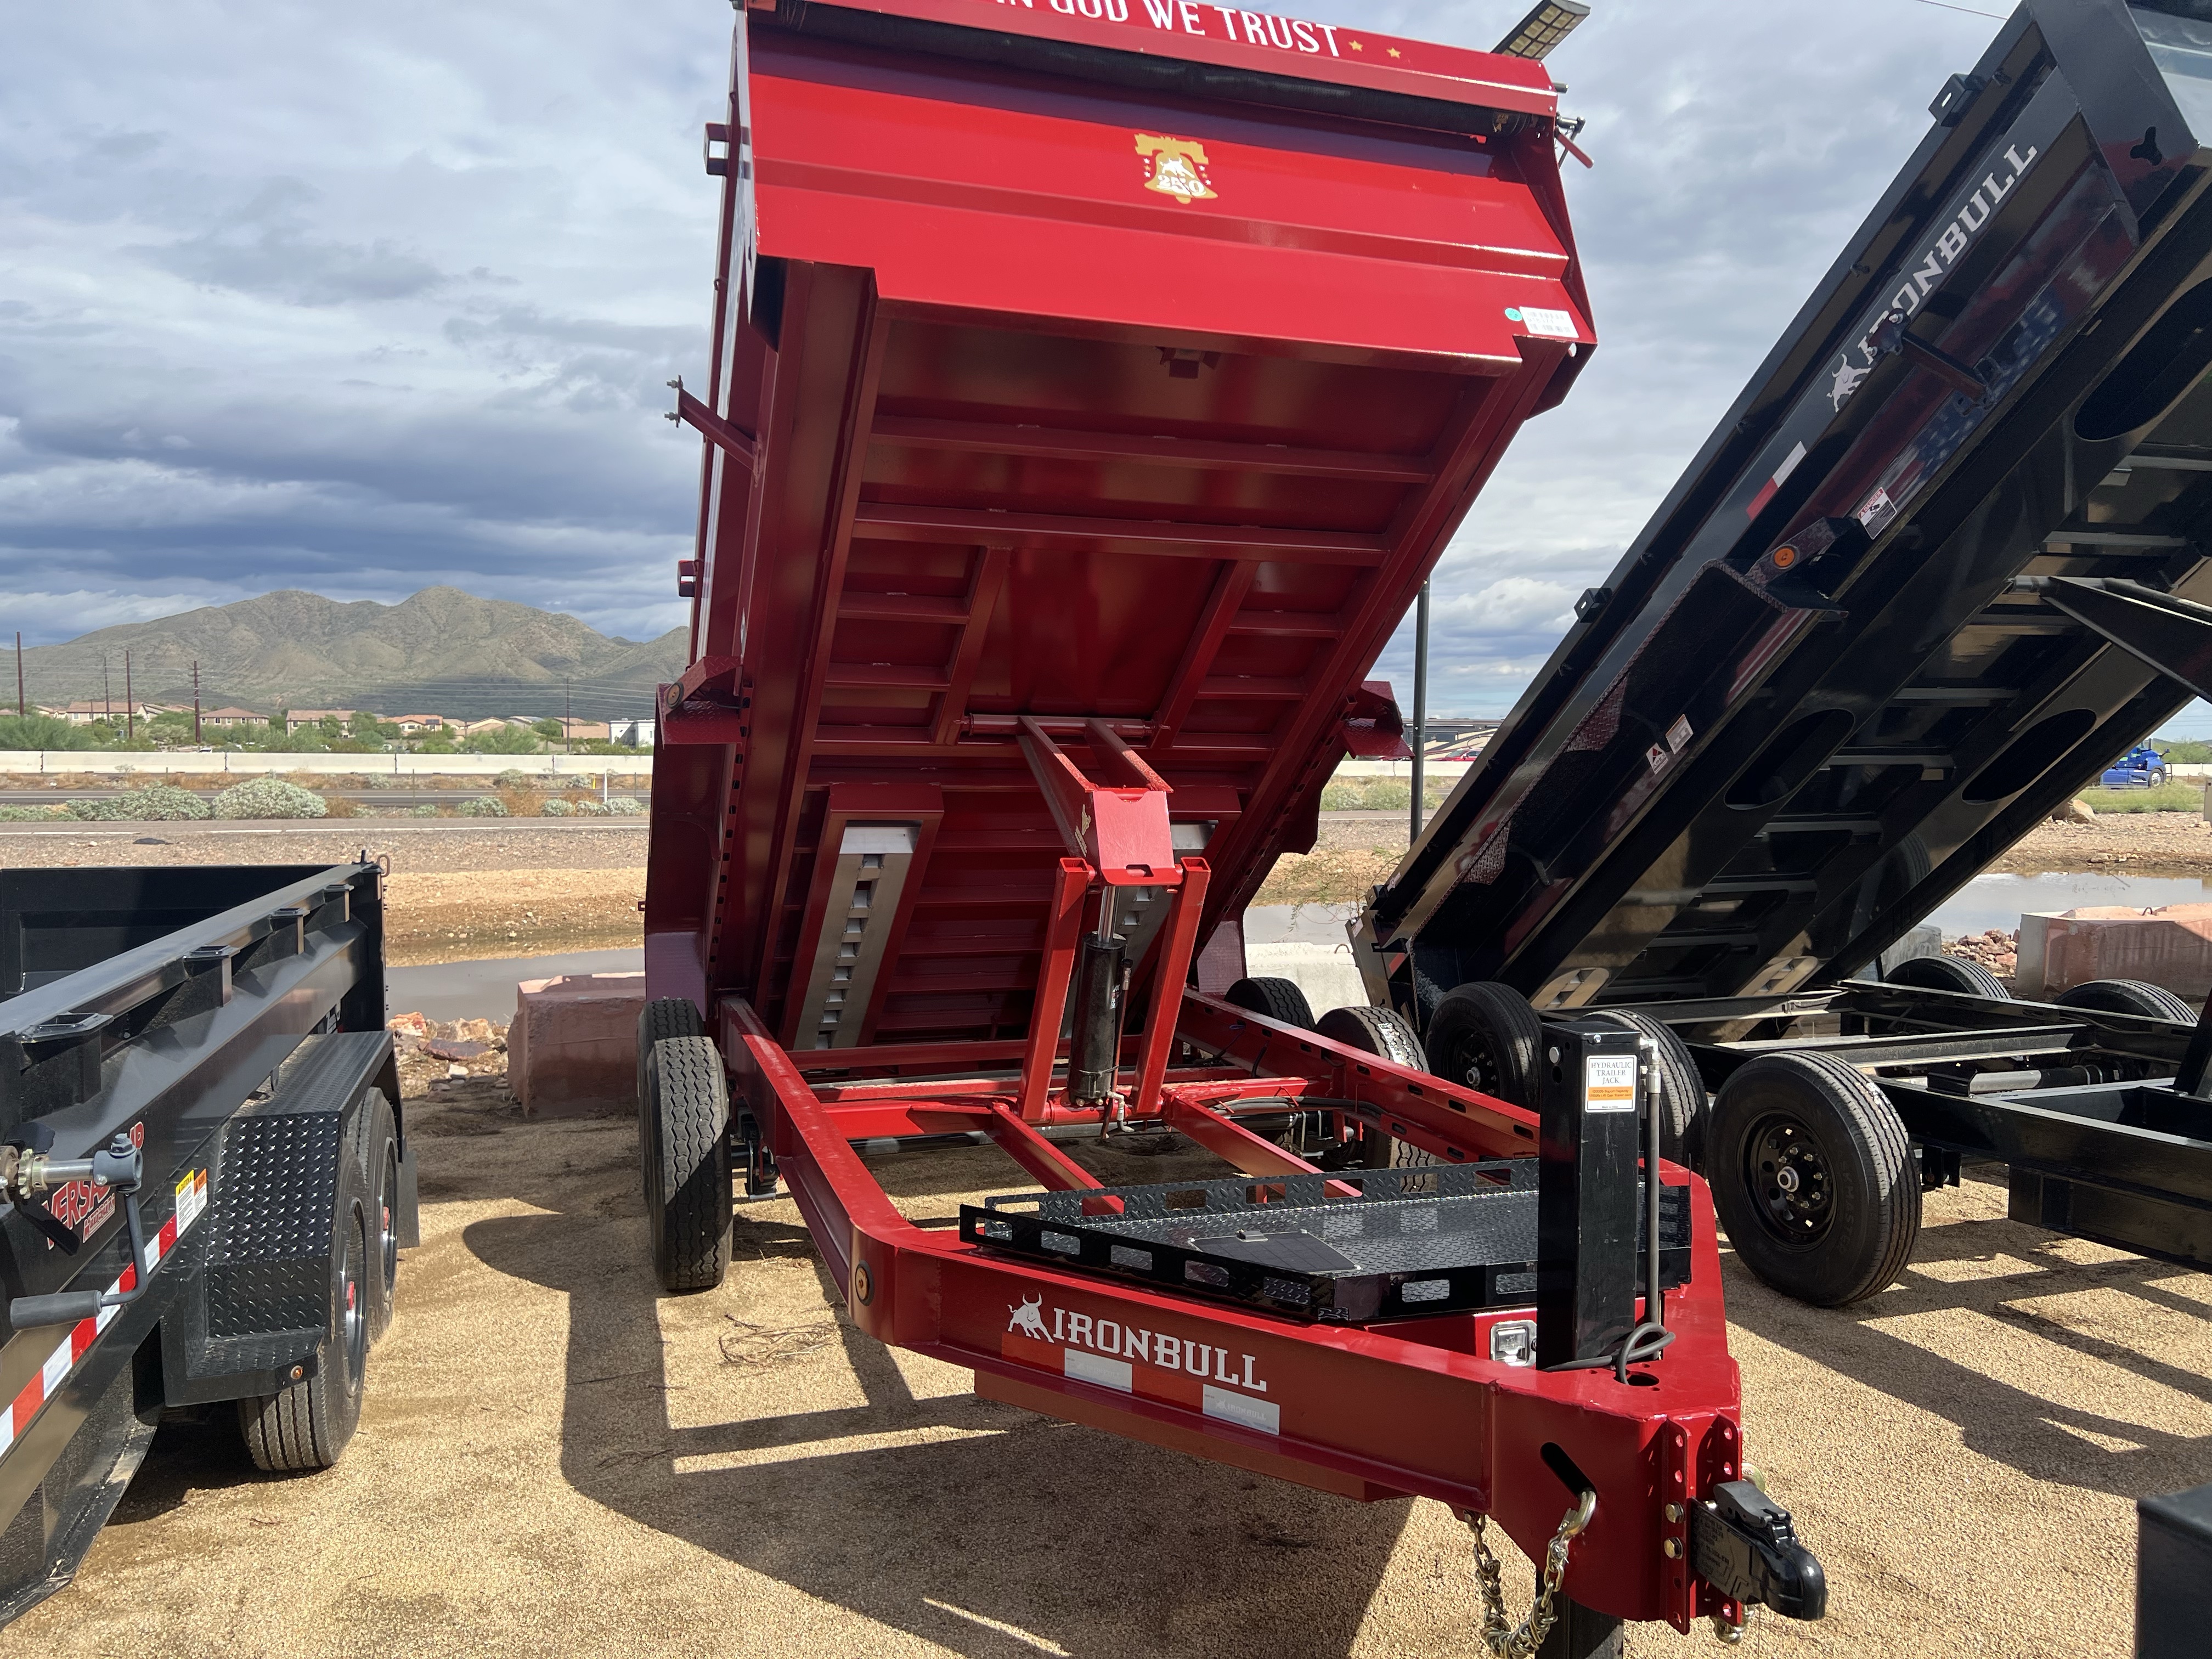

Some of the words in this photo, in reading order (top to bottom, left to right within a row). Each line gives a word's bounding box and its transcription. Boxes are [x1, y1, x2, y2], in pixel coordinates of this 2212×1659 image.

[1143, 0, 1205, 36] WE
[1214, 6, 1340, 57] TRUST
[1156, 174, 1206, 196] 250
[1864, 490, 1882, 512] DANGER
[1053, 1307, 1267, 1392] IRONBULL
